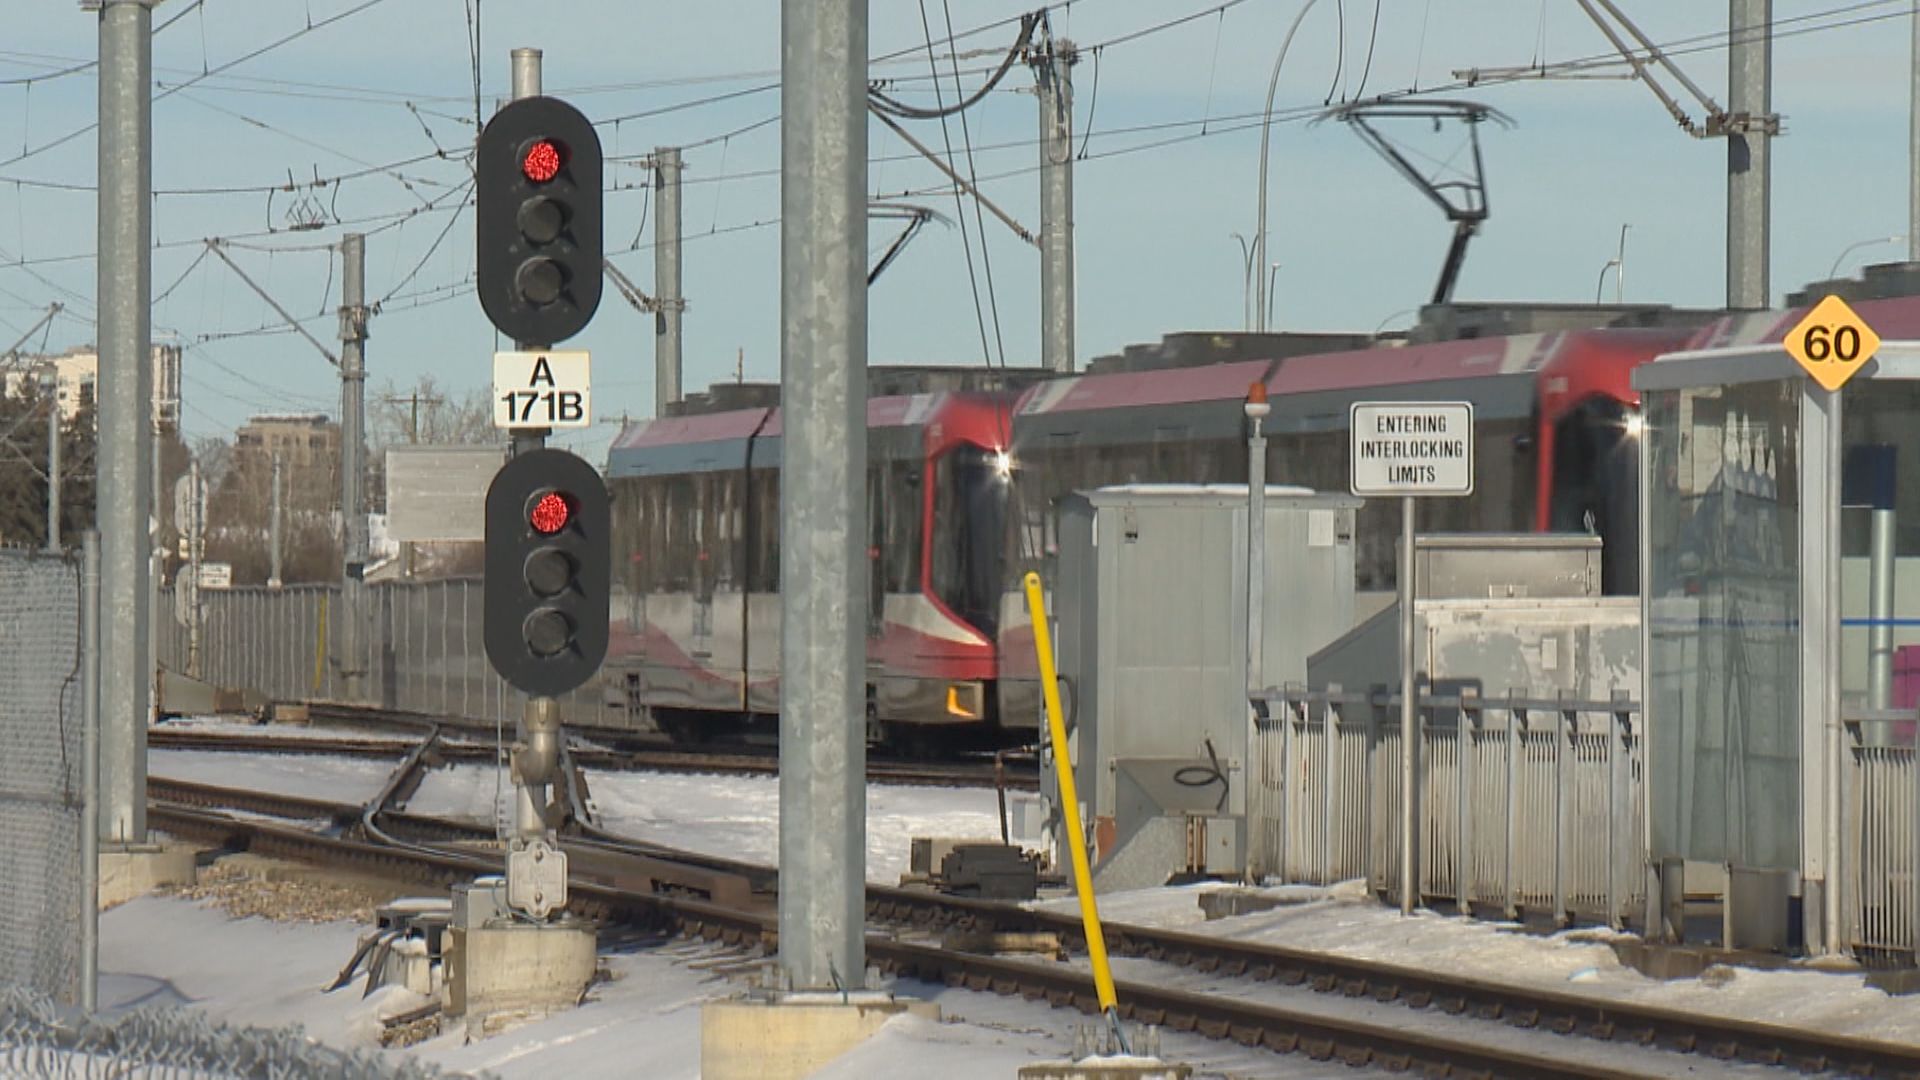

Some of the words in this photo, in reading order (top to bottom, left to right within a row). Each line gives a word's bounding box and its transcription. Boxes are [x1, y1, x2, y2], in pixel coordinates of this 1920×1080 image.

[1804, 325, 1861, 362] 60
[529, 356, 555, 387] A
[501, 391, 583, 422] 171B
[1377, 415, 1447, 433] ENTERING
[1361, 440, 1463, 458] INTERLOCKING
[1388, 465, 1436, 484] LIMITS
